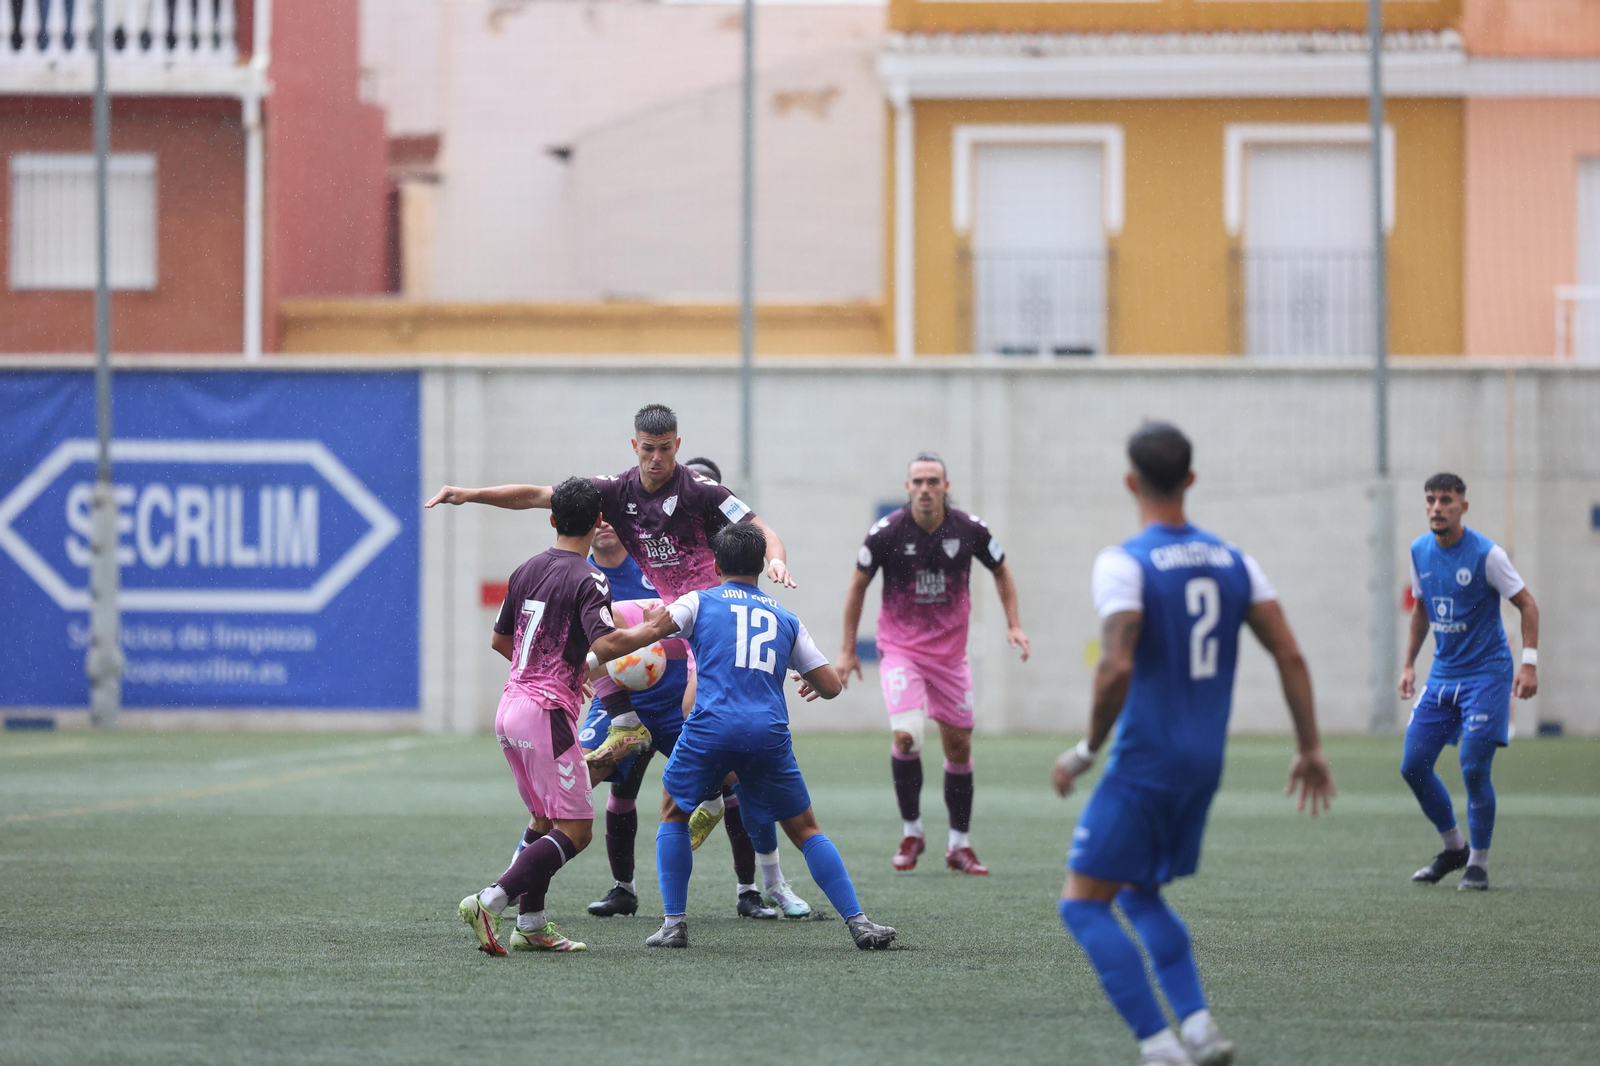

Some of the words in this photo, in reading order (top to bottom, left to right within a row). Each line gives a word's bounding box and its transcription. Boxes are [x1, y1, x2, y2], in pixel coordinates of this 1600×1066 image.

[65, 483, 319, 567] SECRILIM
[721, 589, 748, 599] JAVI
[519, 599, 546, 674] 7
[730, 604, 778, 675] 12
[1185, 576, 1220, 680] 2
[886, 667, 907, 691] 15
[589, 709, 608, 728] 7
[517, 739, 534, 749] SOL
